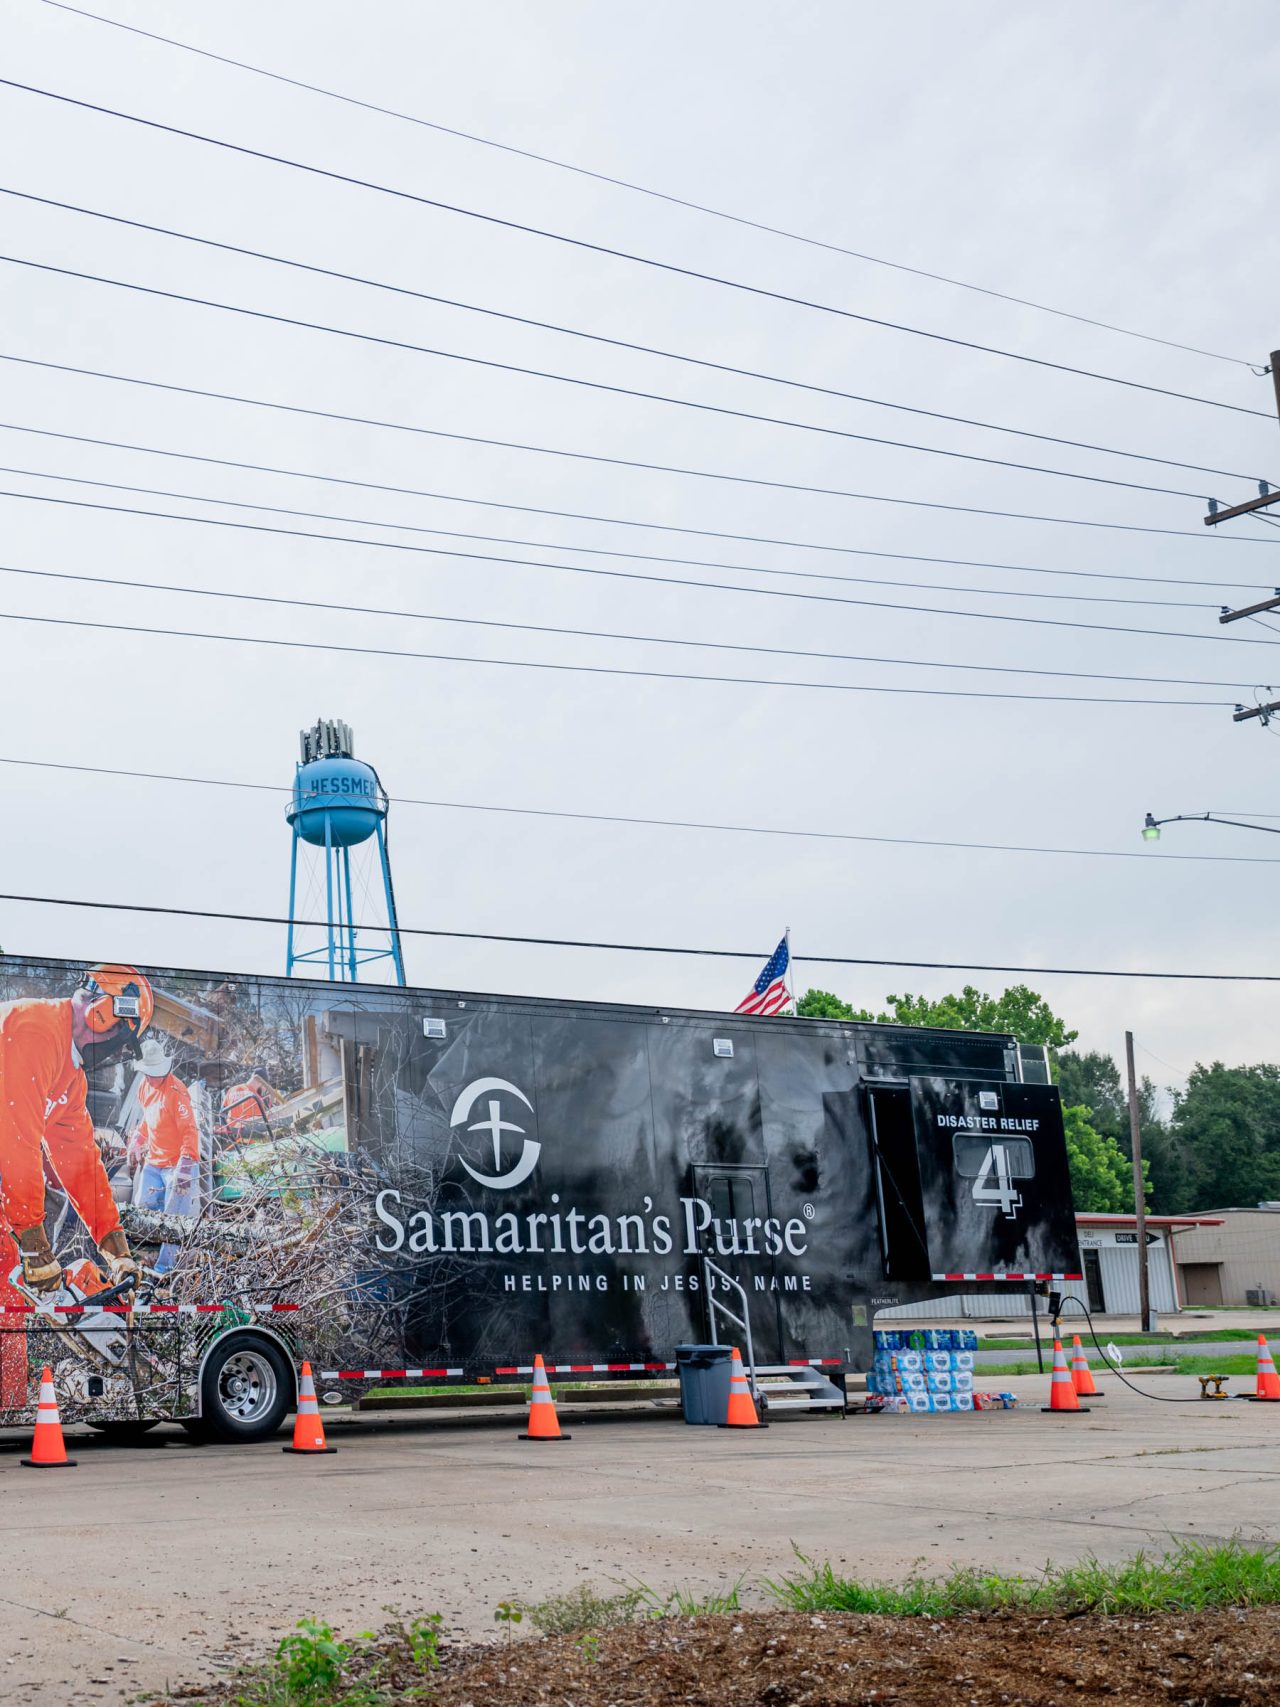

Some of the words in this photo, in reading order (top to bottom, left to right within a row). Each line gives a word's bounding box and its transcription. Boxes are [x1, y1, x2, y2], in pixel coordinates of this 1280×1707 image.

[937, 1114, 997, 1129] DISASTER
[1000, 1118, 1040, 1131] RELIEF
[972, 1145, 1022, 1219] 4
[375, 1189, 673, 1254] Samaritan's
[1116, 1234, 1133, 1242] DRIVE
[504, 1274, 608, 1291] HELPING
[623, 1274, 645, 1291] IN
[754, 1275, 812, 1291] NAME
